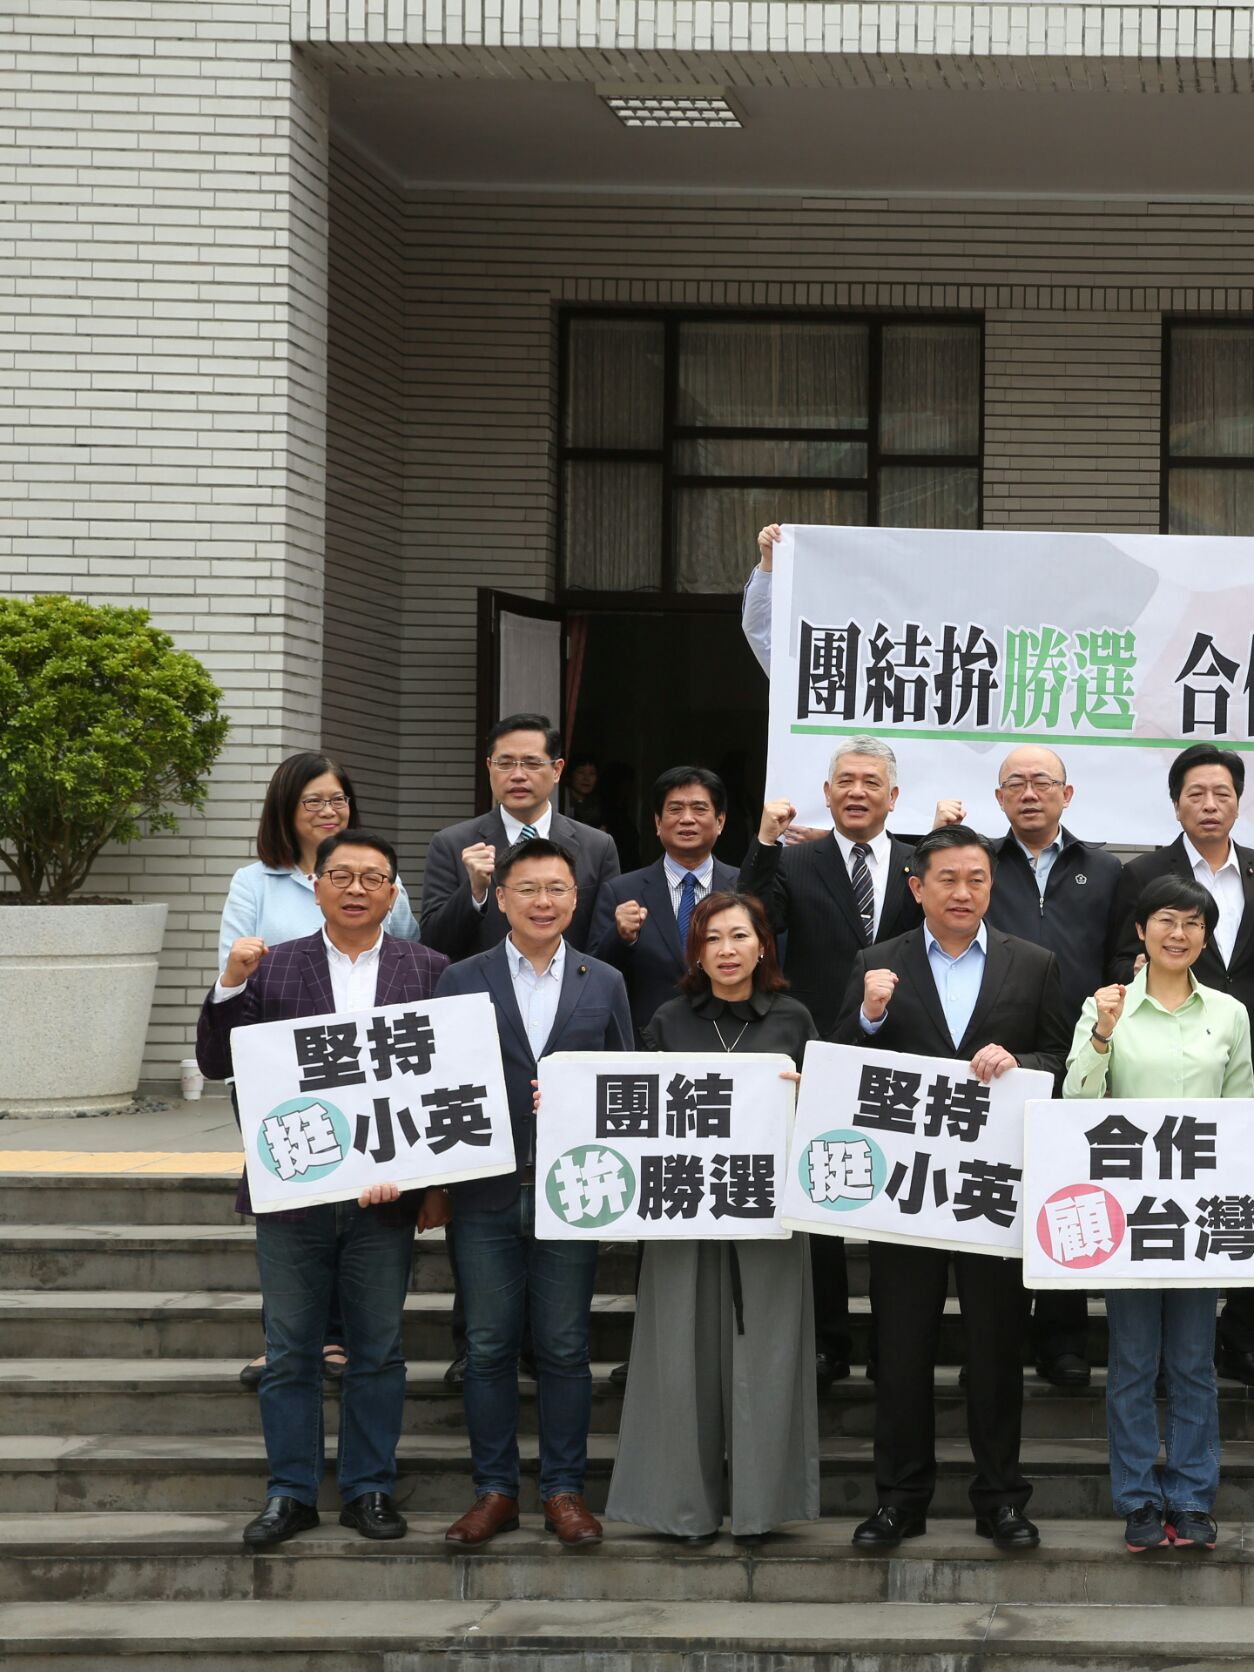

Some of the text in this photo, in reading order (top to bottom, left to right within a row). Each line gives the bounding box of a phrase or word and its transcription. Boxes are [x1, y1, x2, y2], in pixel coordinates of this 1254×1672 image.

[796, 618, 1136, 731] 團結拚勝選
[293, 1012, 436, 1092] 堅持
[262, 1084, 493, 1181] 挺小英
[595, 1072, 735, 1139] 團結
[852, 1065, 991, 1142] 堅持
[808, 1139, 1024, 1228] 挺小英
[1084, 1114, 1218, 1180] 合作
